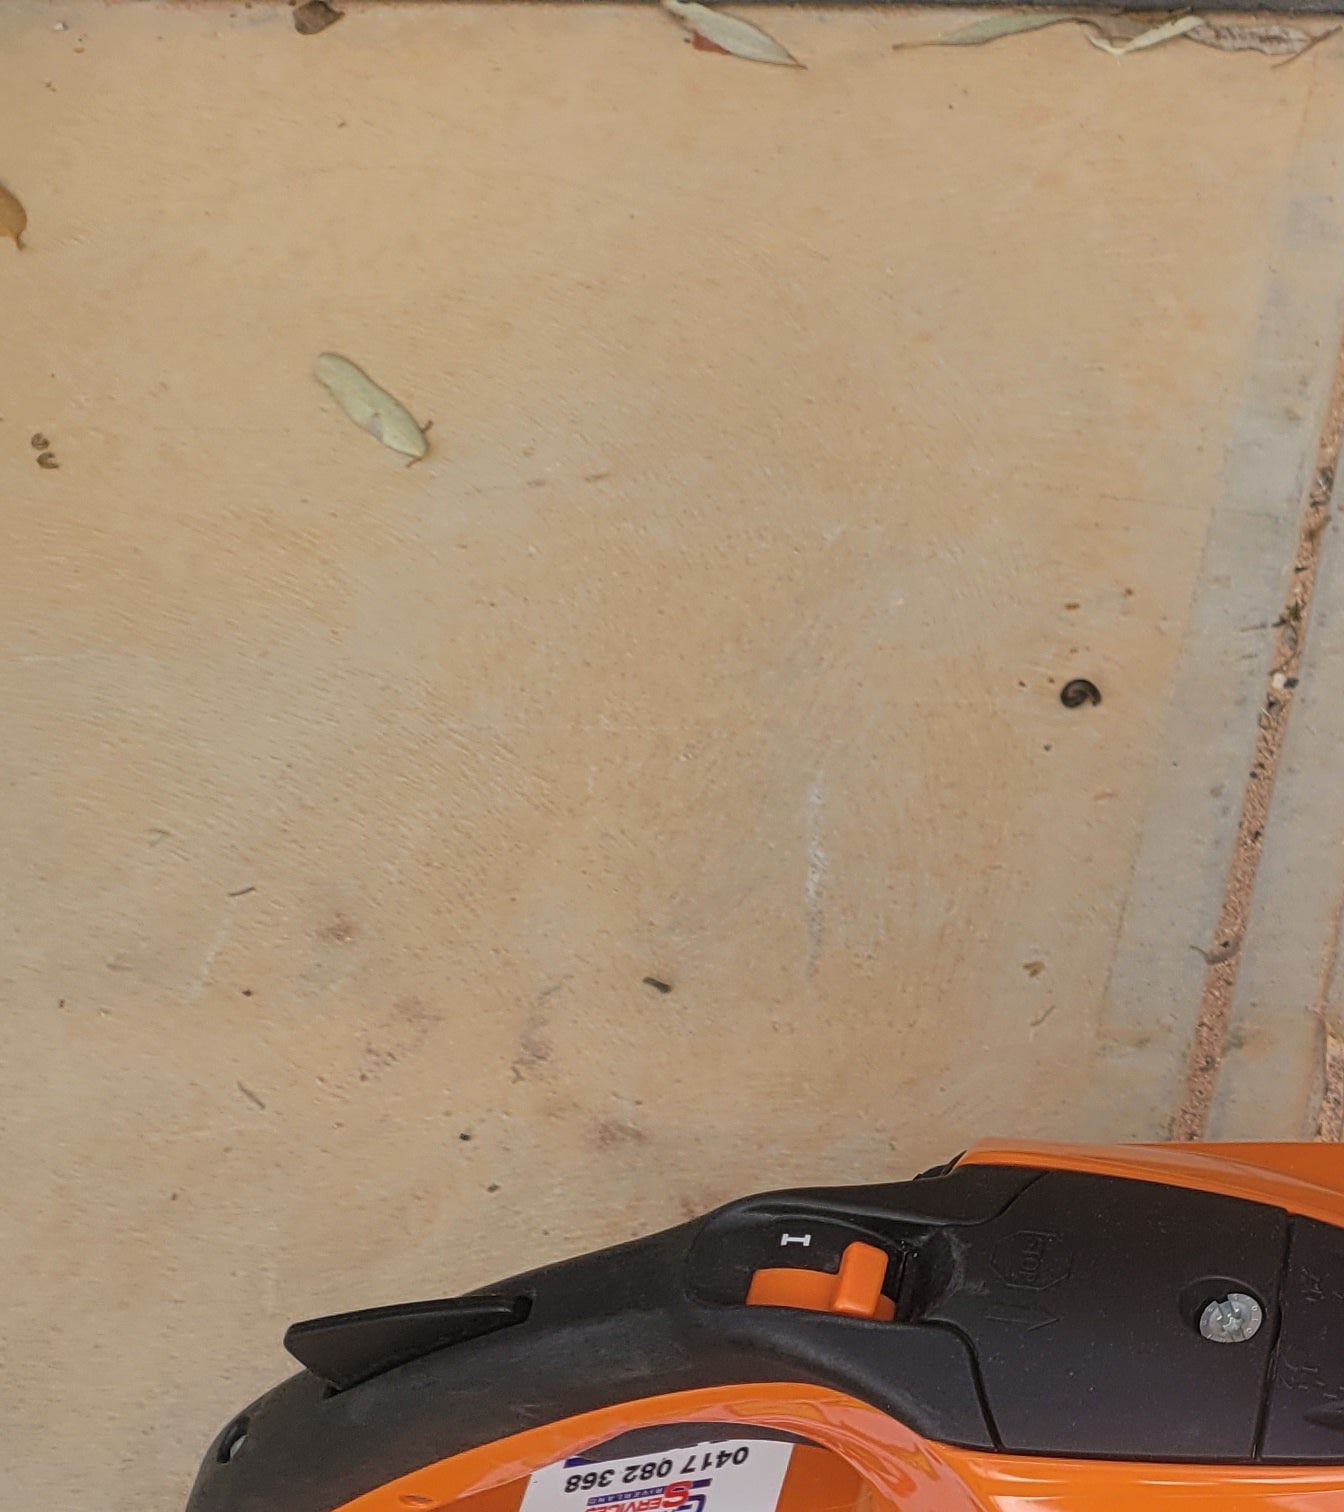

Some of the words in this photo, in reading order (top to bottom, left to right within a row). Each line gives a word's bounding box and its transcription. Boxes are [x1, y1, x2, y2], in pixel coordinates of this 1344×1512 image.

[622, 1458, 674, 1484] 082
[680, 1446, 750, 1475] 0417
[564, 1468, 616, 1494] 368
